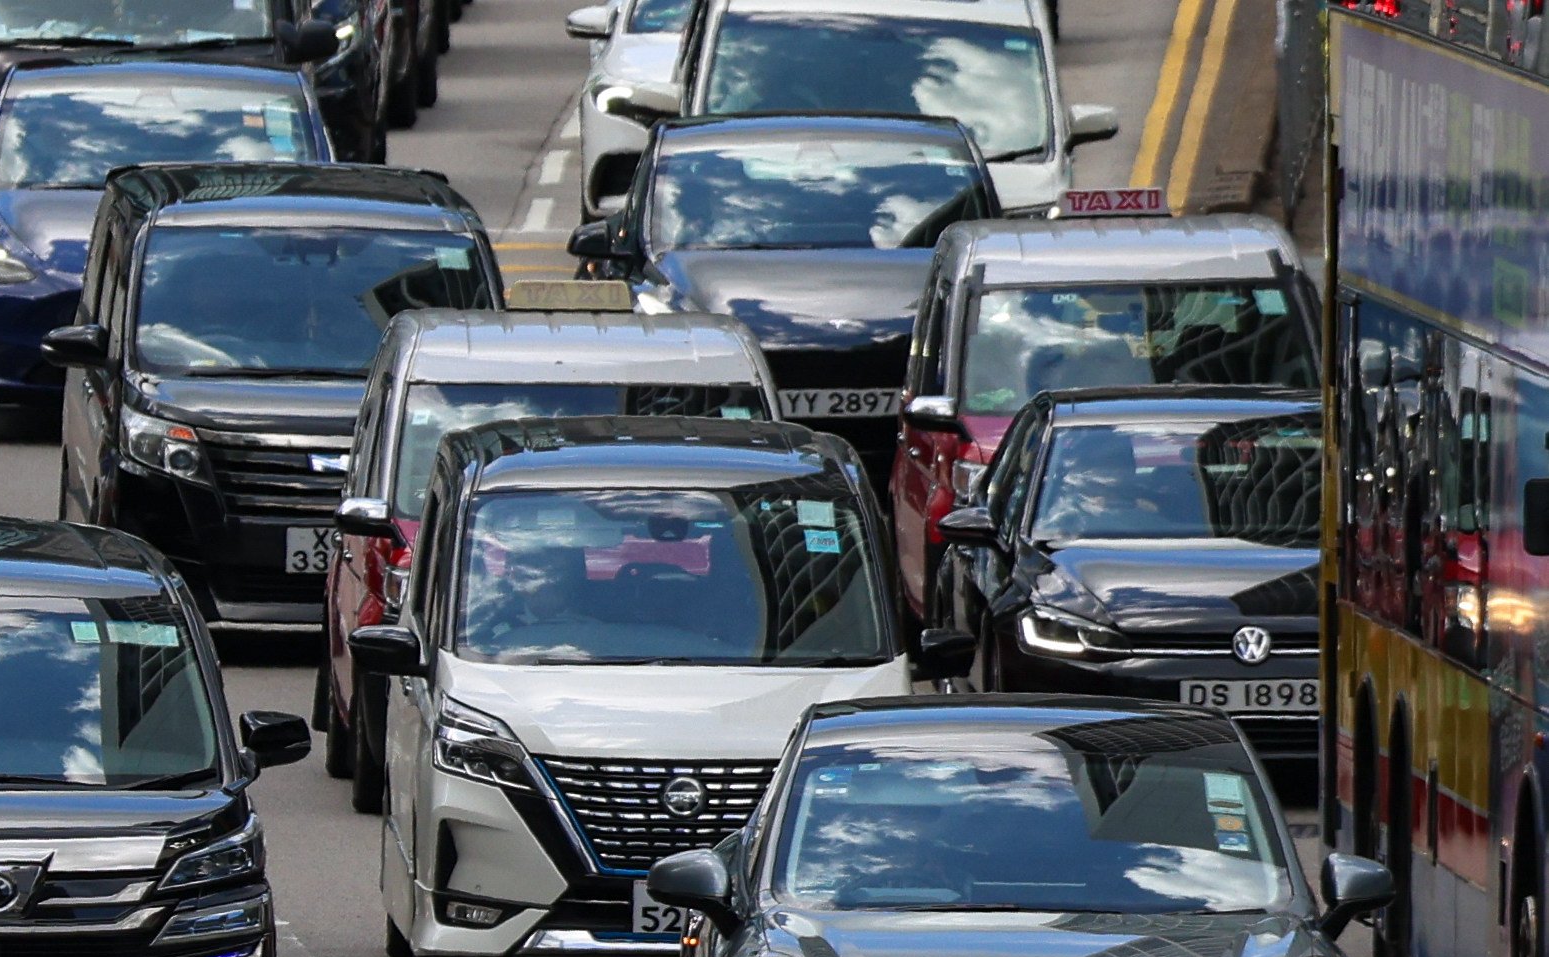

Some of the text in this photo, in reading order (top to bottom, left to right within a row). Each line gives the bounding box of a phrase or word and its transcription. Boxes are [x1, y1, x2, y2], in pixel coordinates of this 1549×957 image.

[1066, 190, 1160, 211] TAXI
[521, 282, 622, 304] TAXI
[787, 392, 895, 413] YY 2897
[292, 550, 334, 571] 33
[1190, 683, 1317, 706] DS 1898
